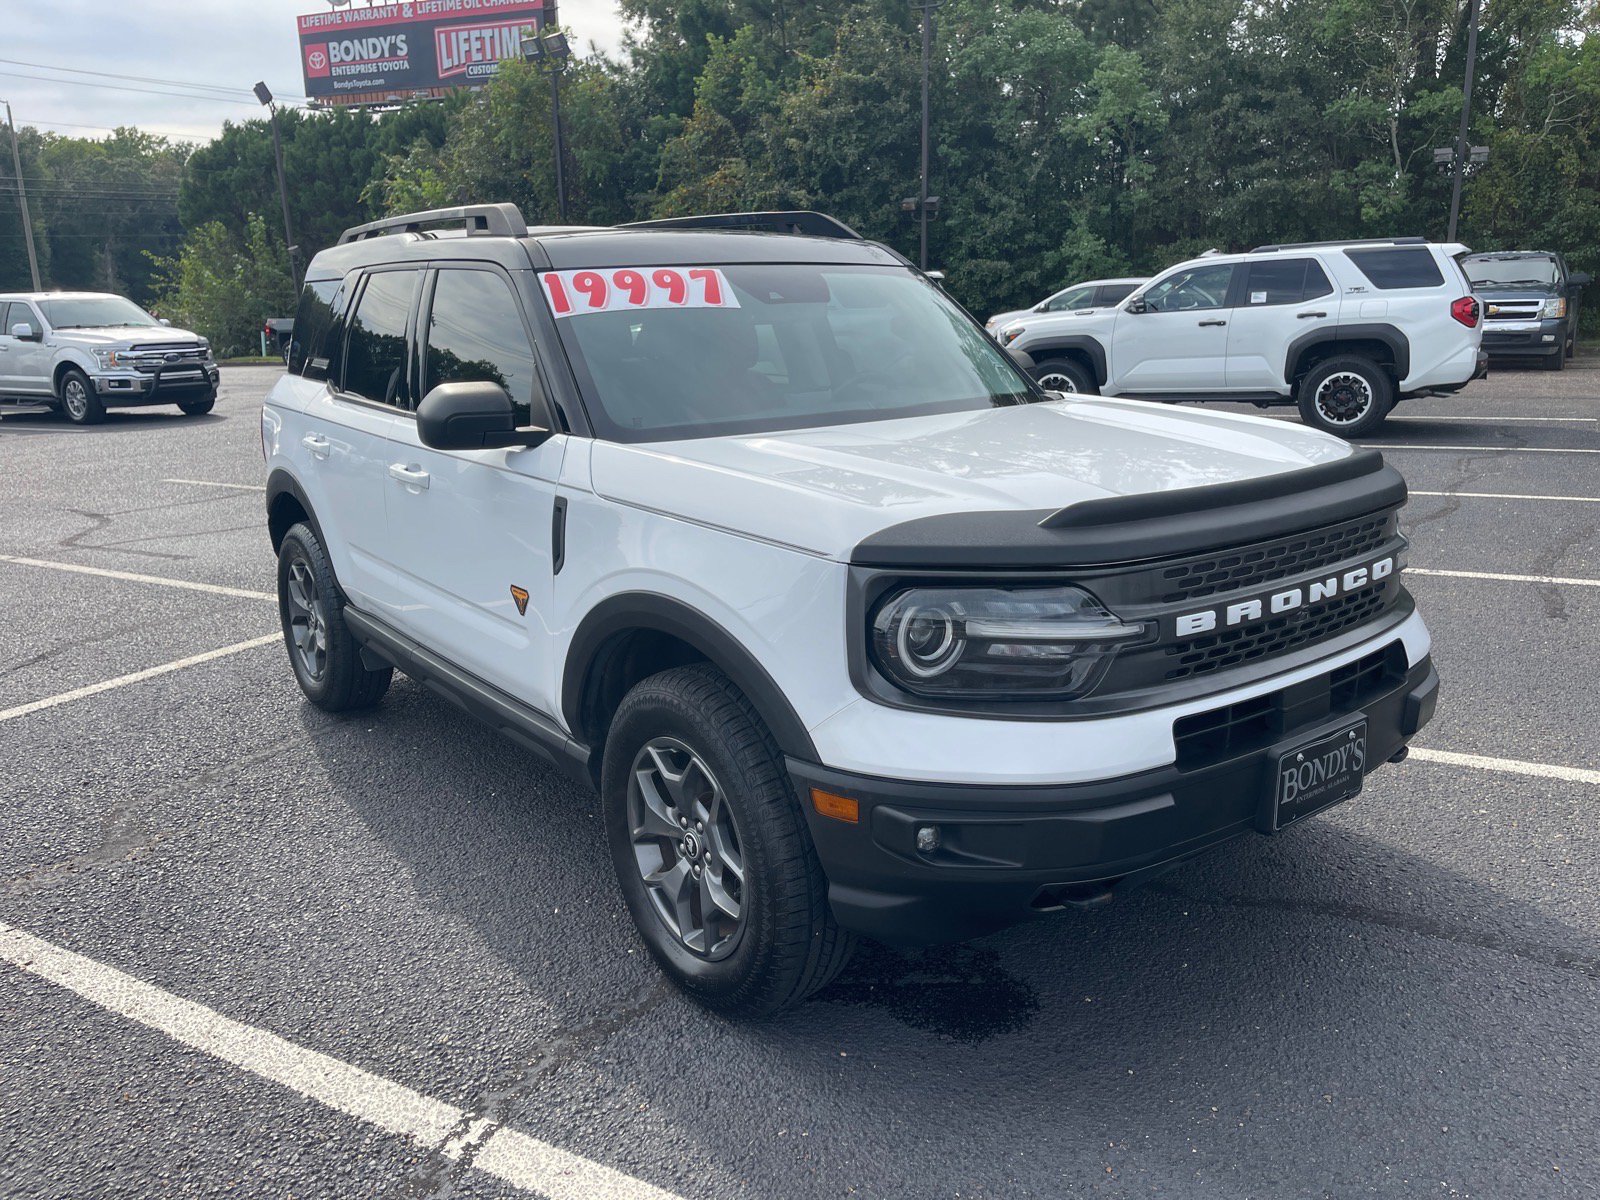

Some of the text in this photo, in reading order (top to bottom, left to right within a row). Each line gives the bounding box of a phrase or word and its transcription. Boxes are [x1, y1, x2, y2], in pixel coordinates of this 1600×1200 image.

[301, 12, 342, 28] LIFETIME
[342, 5, 398, 22] WARRANTY
[402, 3, 413, 18] &
[416, 0, 462, 14] LIFETIME
[463, 0, 482, 9] OIL
[328, 34, 408, 63] BONDY'S
[331, 60, 410, 76] ENTERPRISE TOYOTA
[543, 269, 723, 313] 19997
[1176, 557, 1393, 637] BRONCO
[1280, 738, 1365, 805] BONDY'S
